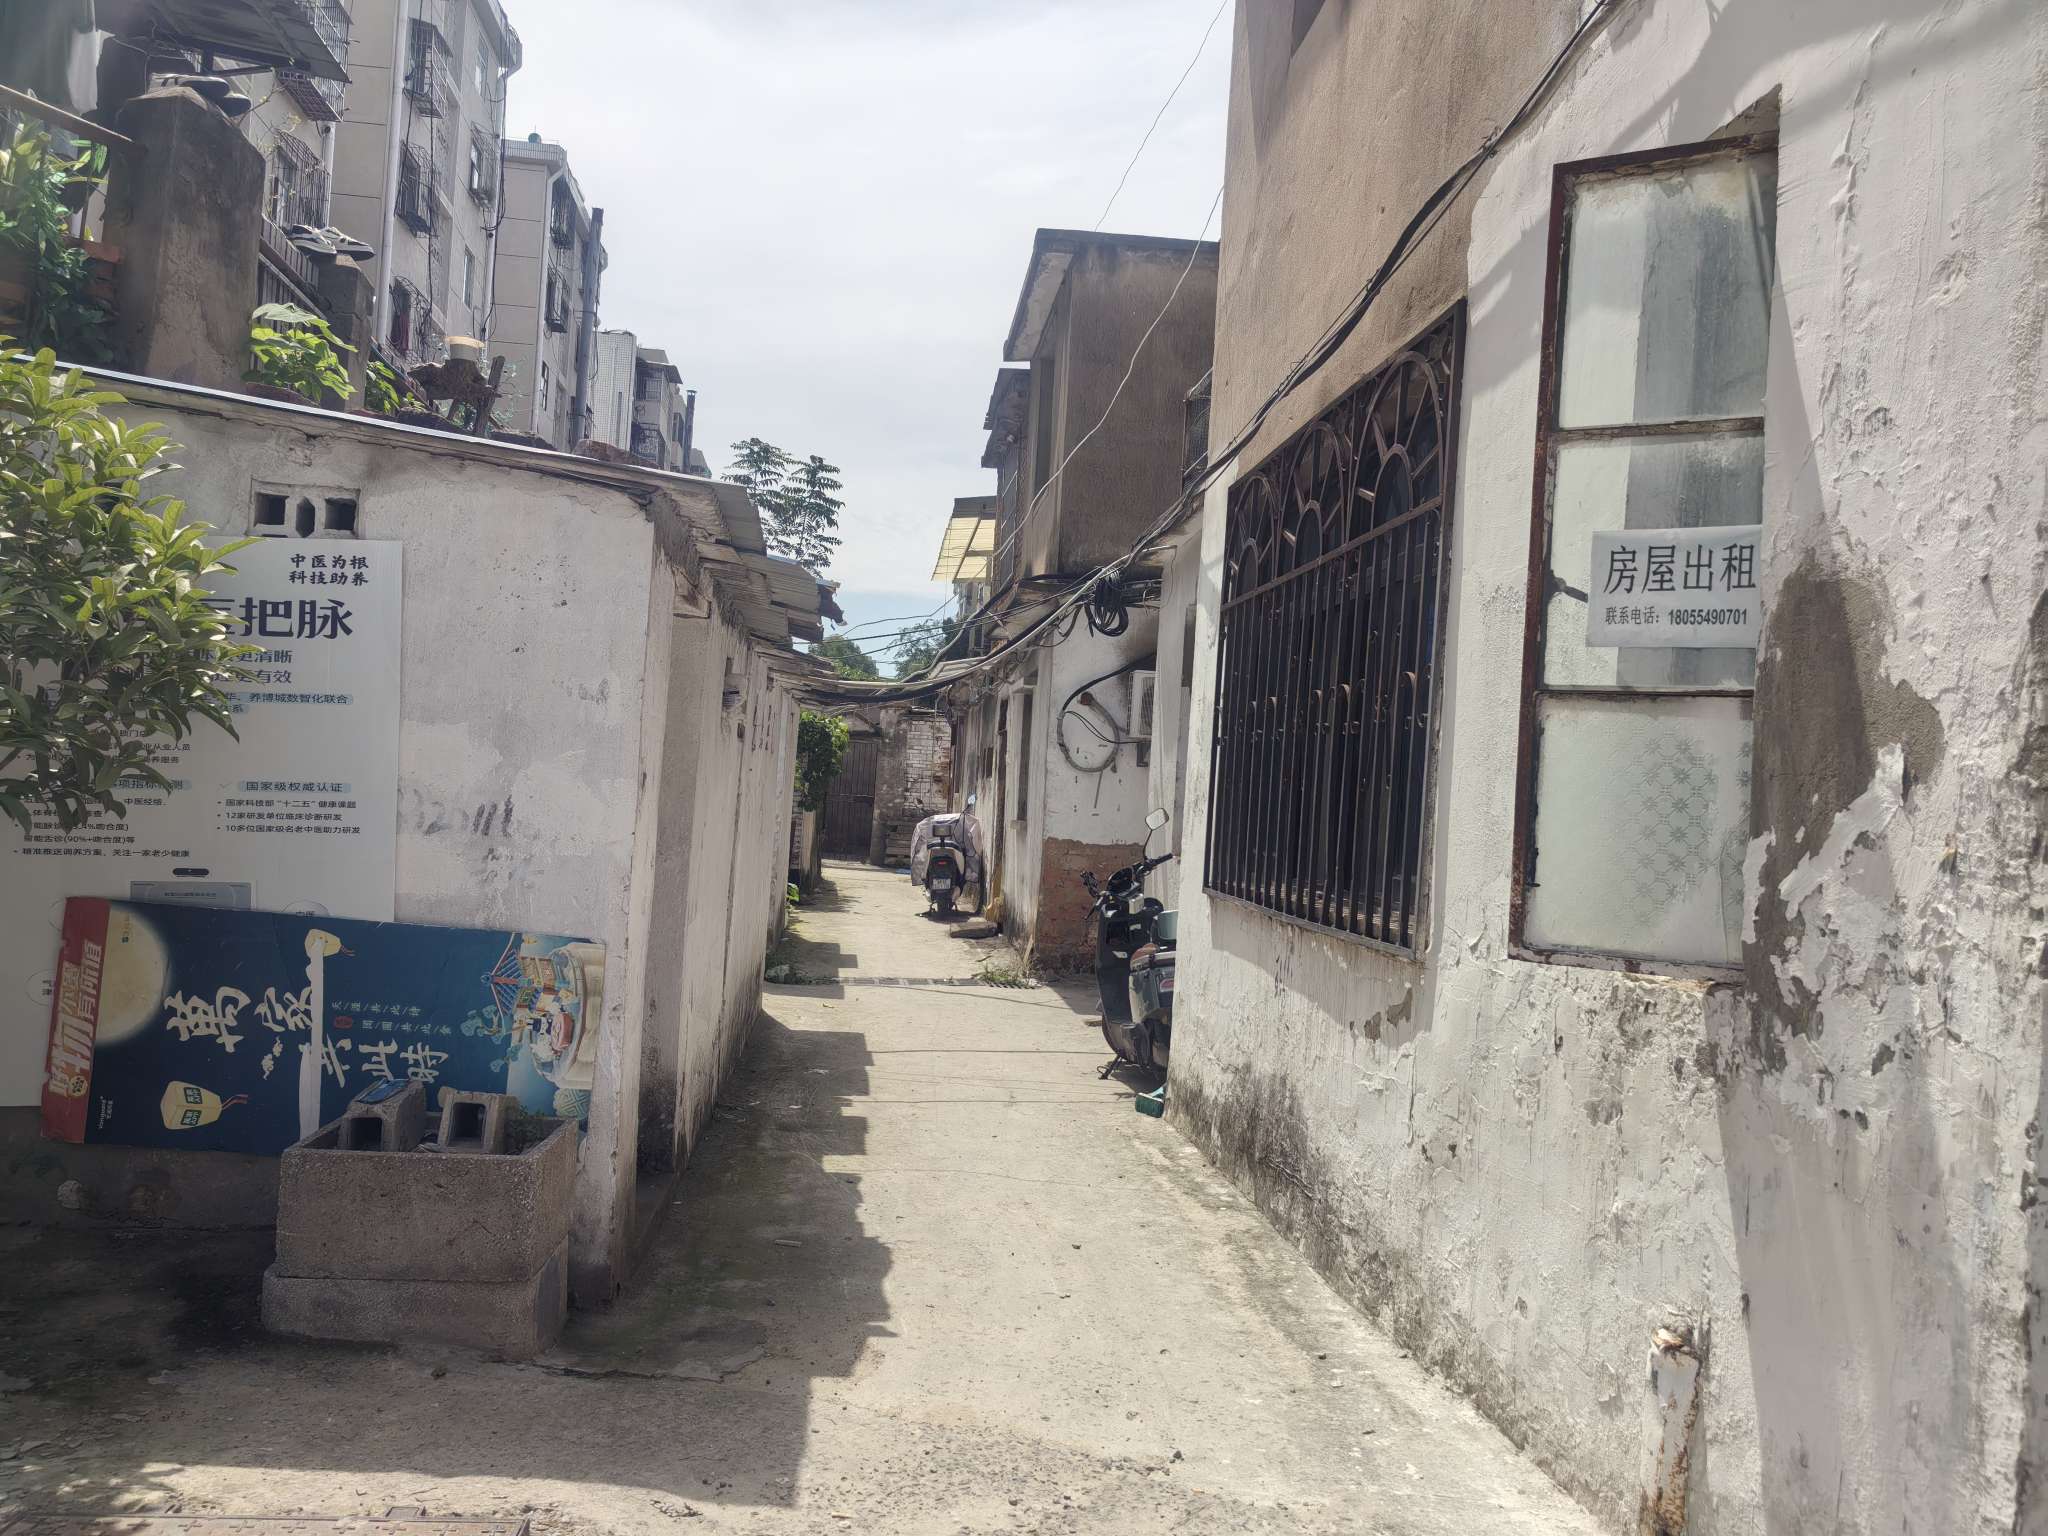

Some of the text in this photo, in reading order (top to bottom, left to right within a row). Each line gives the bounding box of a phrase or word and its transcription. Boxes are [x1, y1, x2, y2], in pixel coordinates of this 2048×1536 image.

[290, 553, 369, 570] 中医为根
[1603, 543, 1757, 594] 房屋出租
[289, 570, 369, 586] 科技助养
[1668, 608, 1748, 625] 18055490701
[246, 781, 343, 792] 国家级权威认证
